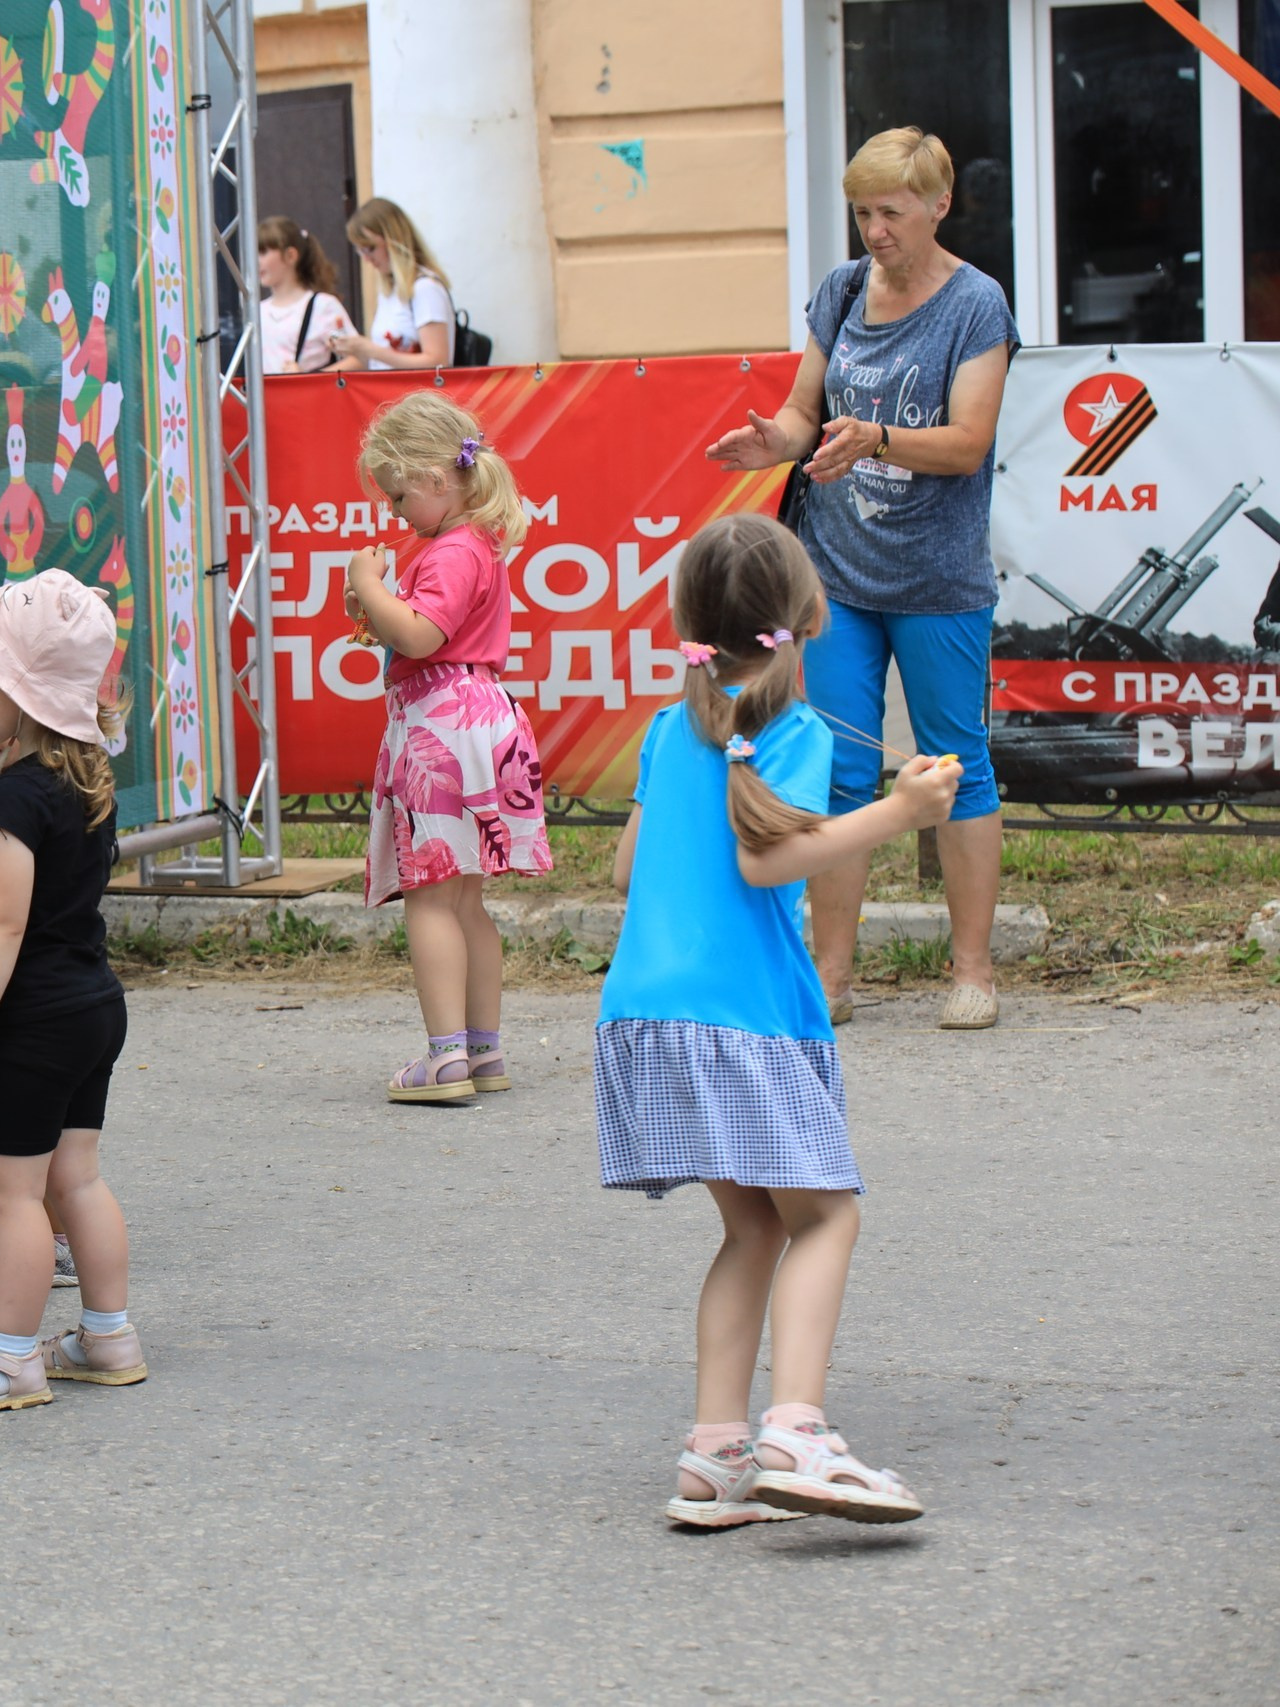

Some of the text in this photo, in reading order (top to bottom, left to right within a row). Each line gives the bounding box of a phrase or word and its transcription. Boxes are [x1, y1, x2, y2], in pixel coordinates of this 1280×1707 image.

[859, 474, 886, 491] THAN
[1059, 483, 1158, 512] МАЯ
[1061, 670, 1280, 711] С ПРАЗД
[1137, 718, 1280, 771] ВЕЛ
